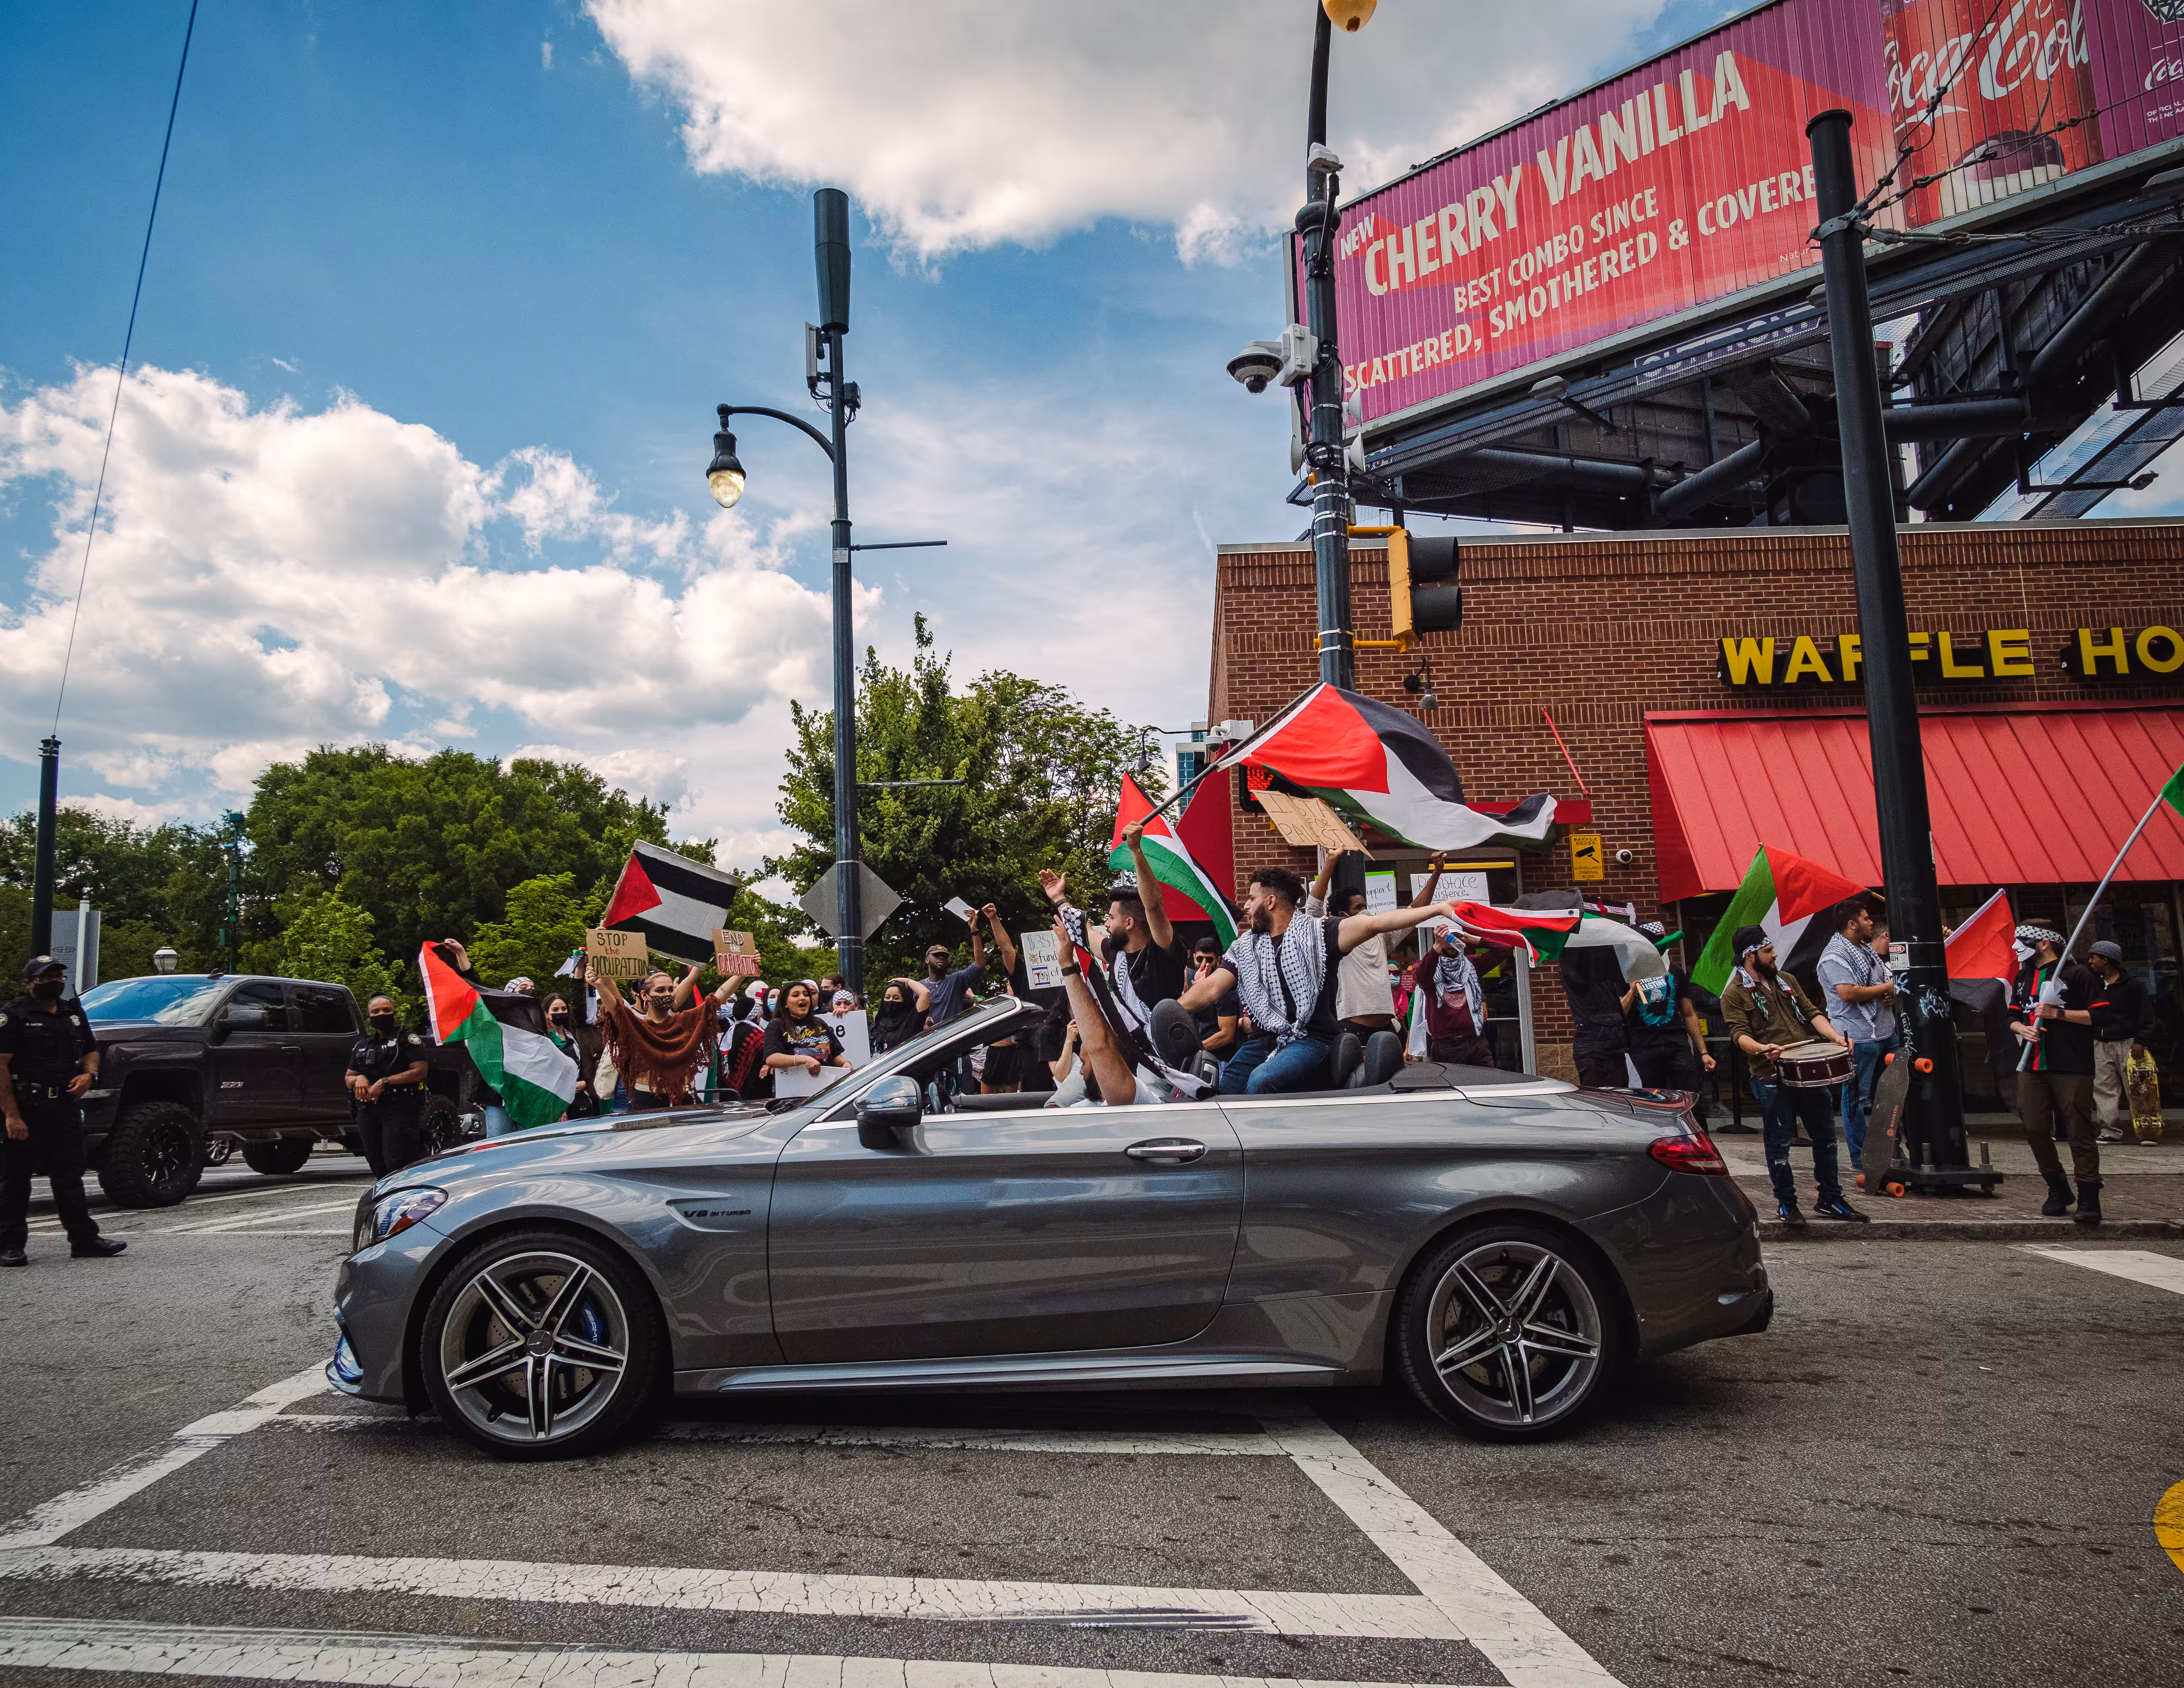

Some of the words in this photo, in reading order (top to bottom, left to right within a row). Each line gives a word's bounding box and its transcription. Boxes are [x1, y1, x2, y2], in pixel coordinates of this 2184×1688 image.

[2147, 101, 2182, 116] OFFICIAL
[2147, 114, 2163, 123] THE
[1364, 162, 1523, 296] CHERRY
[1537, 49, 1750, 206] VANILLA
[1341, 212, 1375, 260] NEW
[1454, 268, 1501, 314] BEST
[1508, 224, 1585, 287] COMBO
[1591, 186, 1659, 243] SINCE
[1343, 323, 1482, 393] SCATTERED,
[1489, 231, 1658, 338] SMOTHERED
[1668, 218, 1689, 251] &
[1256, 792, 1294, 813] I
[1306, 818, 1332, 829] FOR
[597, 932, 628, 946] STOP
[721, 930, 744, 946] END
[605, 946, 620, 955] the
[592, 955, 648, 977] OCCUPATION
[683, 1209, 708, 1217] V8
